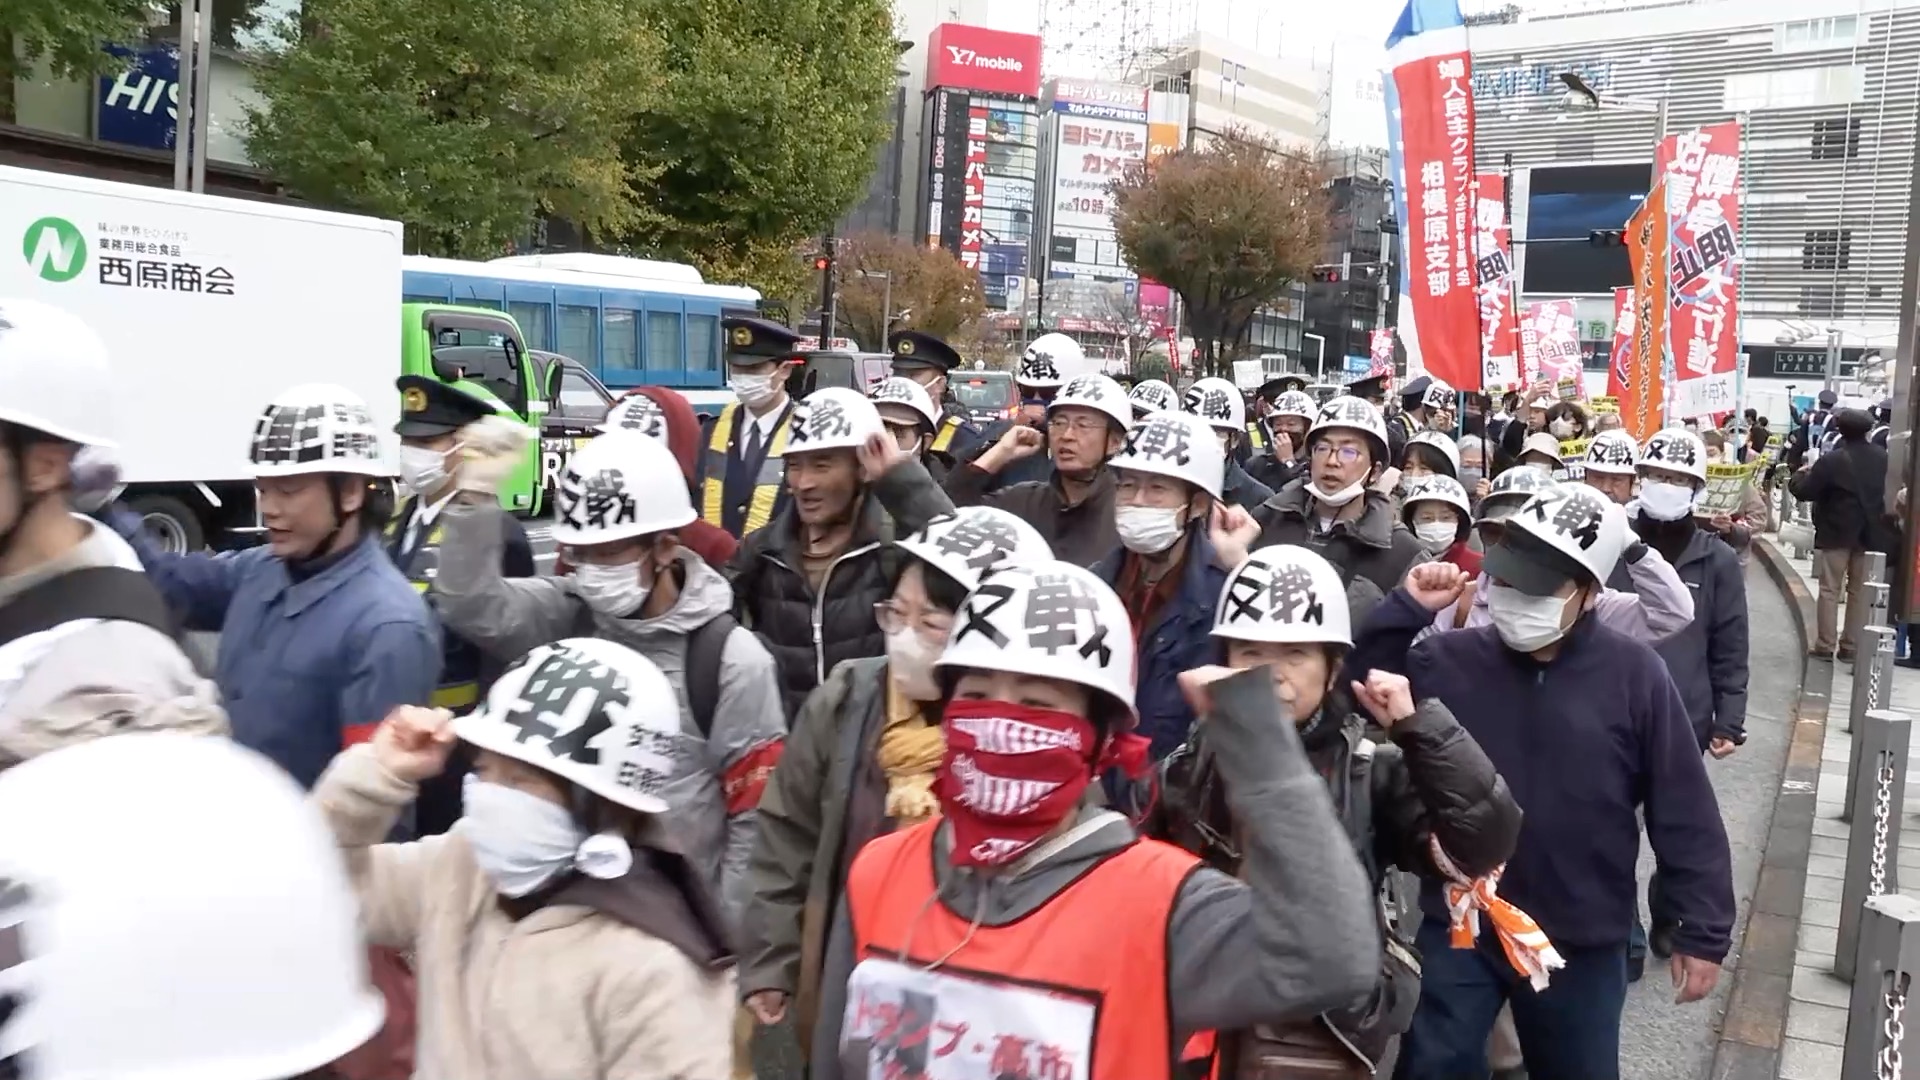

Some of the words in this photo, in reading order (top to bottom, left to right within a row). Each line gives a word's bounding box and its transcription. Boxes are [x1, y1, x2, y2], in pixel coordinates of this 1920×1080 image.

[1063, 124, 1143, 151] ヨドバシ
[960, 117, 987, 269] ヨドバシカメラ
[1421, 160, 1450, 296] 相模原支部
[99, 238, 181, 257] 業務用総合食品
[99, 256, 235, 295] 西原商会
[1182, 386, 1232, 421] 反戦
[1587, 436, 1633, 466] 反戦
[1646, 438, 1697, 467] 反戦
[1222, 558, 1323, 626] 反戦
[957, 566, 1111, 668] 反戦
